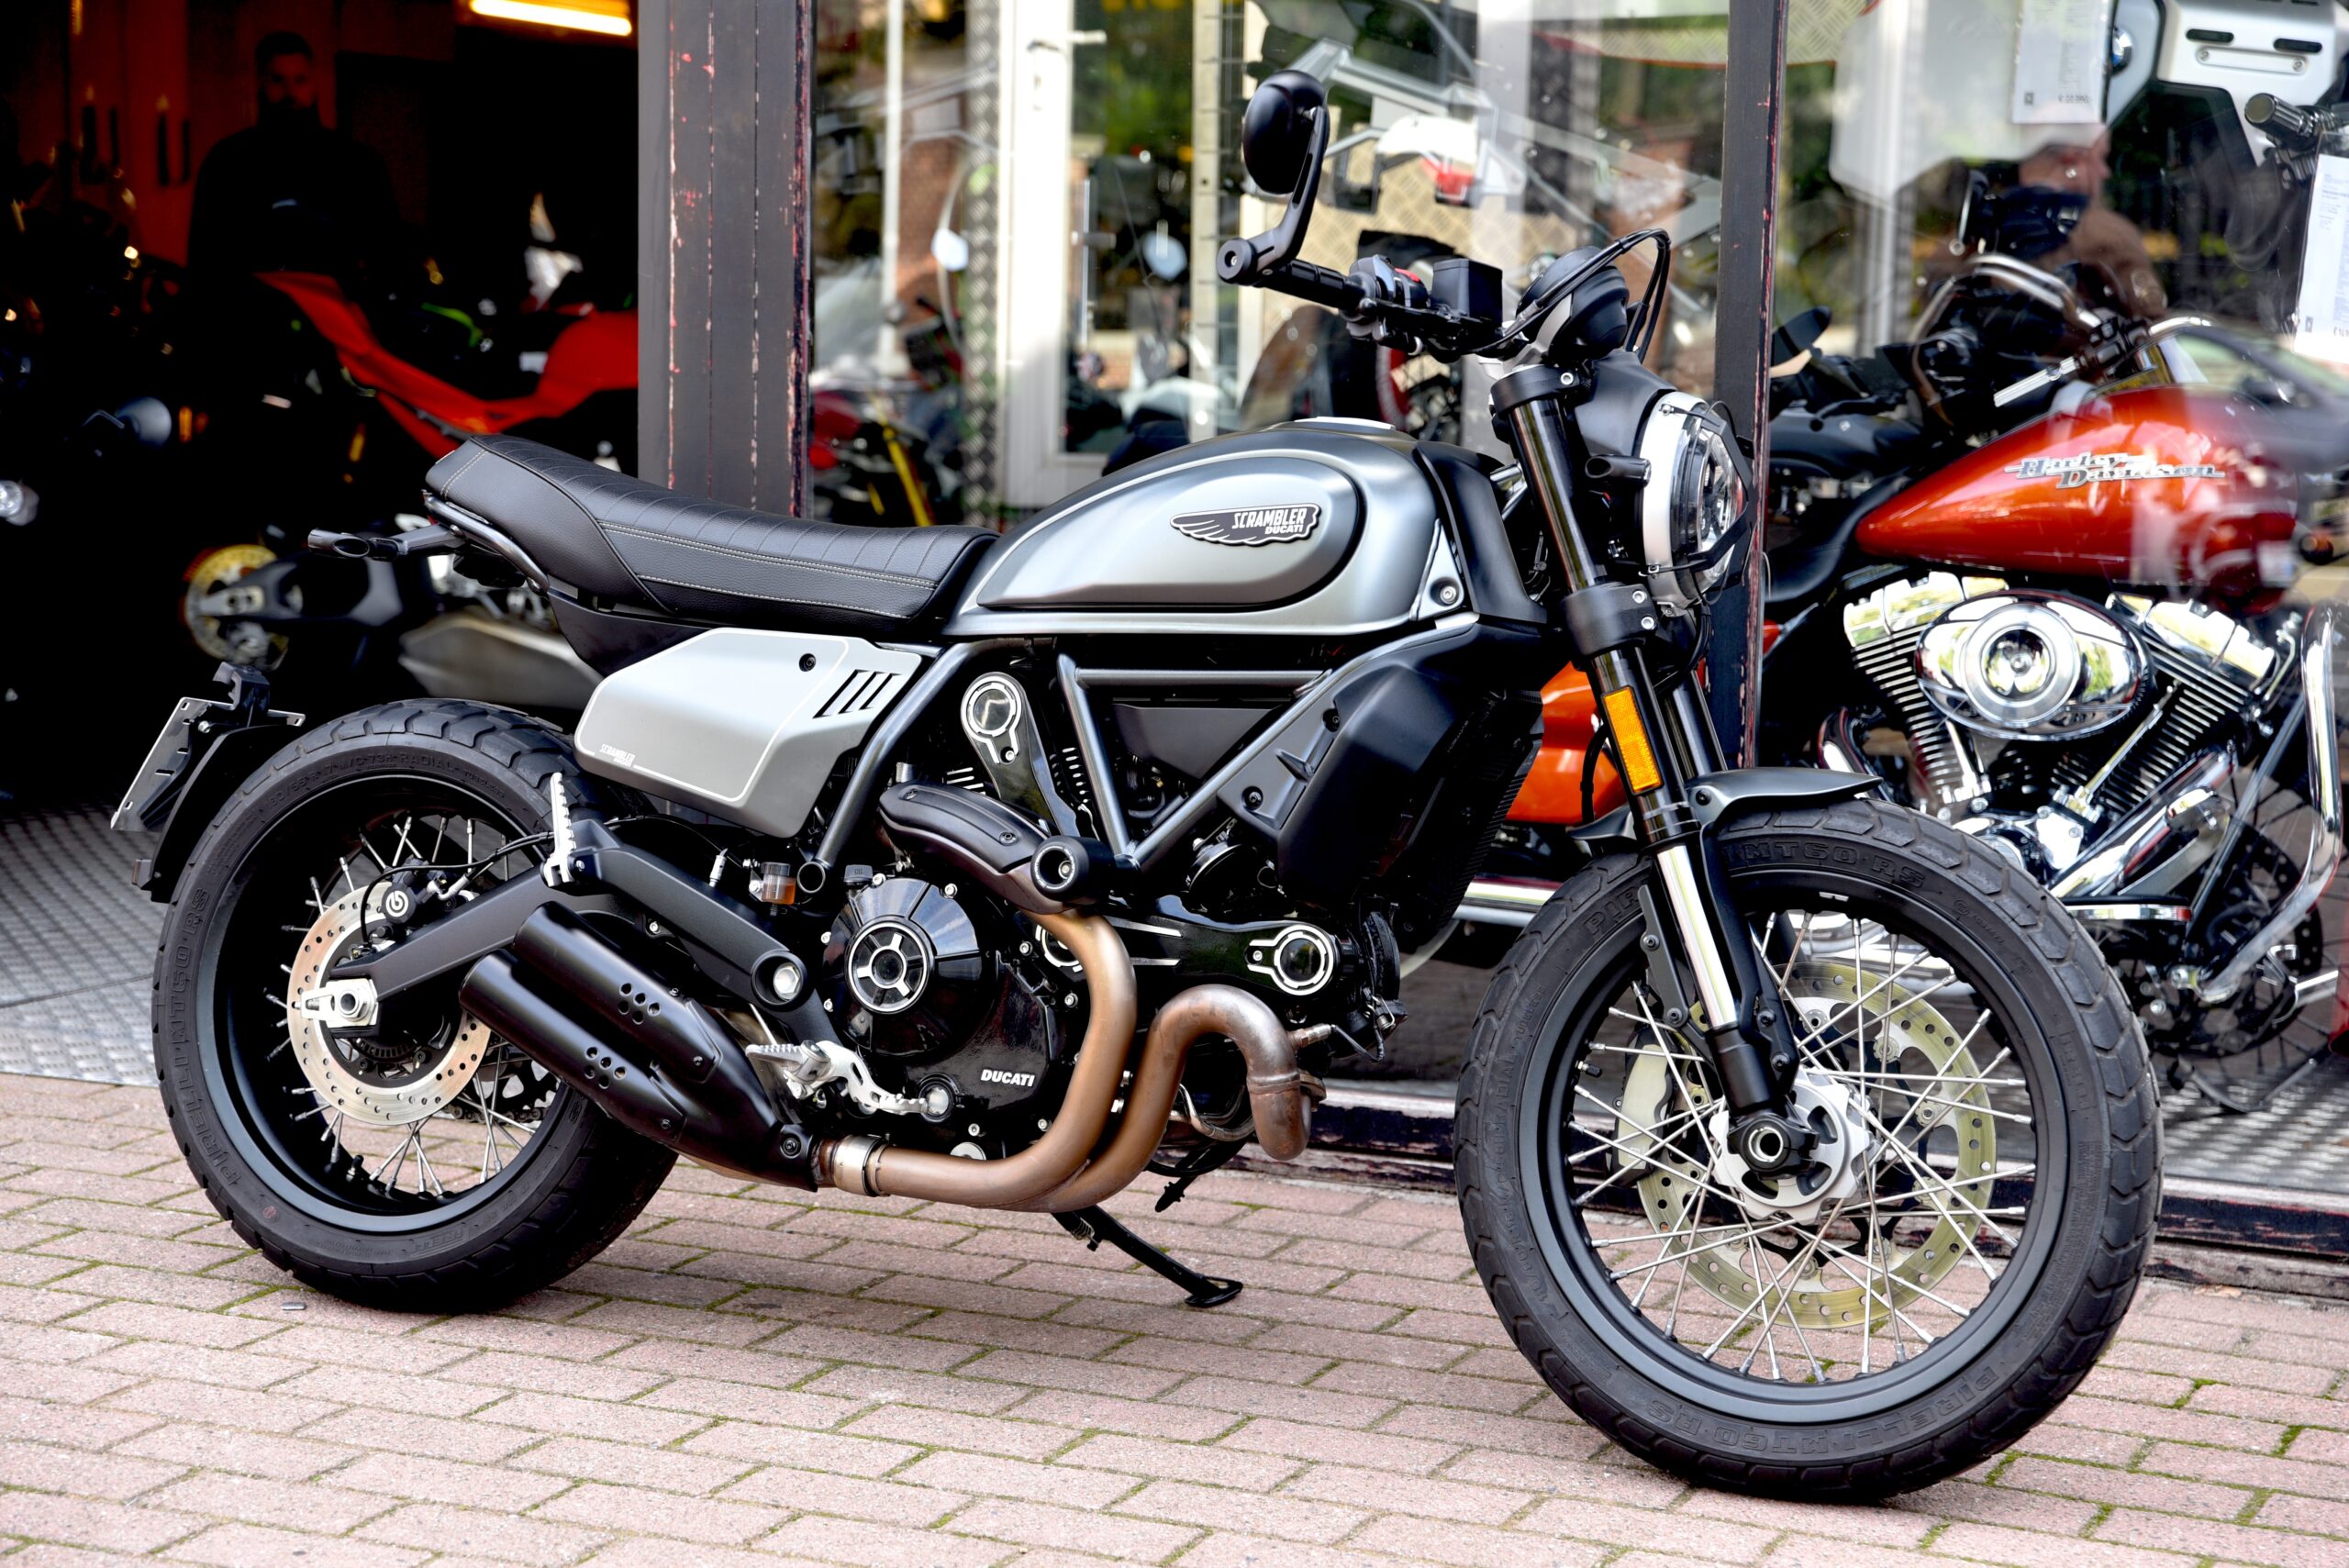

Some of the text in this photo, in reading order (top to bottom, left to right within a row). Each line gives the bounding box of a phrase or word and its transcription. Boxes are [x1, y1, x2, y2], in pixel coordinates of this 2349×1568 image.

[1231, 507, 1308, 529] SCRAMBLER
[1264, 524, 1303, 535] DUCATI
[599, 743, 637, 762] SCRAMBLER
[1744, 840, 1859, 865] MT60
[1871, 854, 1927, 889] RS
[169, 887, 240, 1185] PIRELLI MT60 RS
[980, 1069, 1035, 1087] DUCATI
[1491, 1050, 1520, 1127] RADIAL
[1647, 1364, 2001, 1454] PIRELLI MT60 RS
